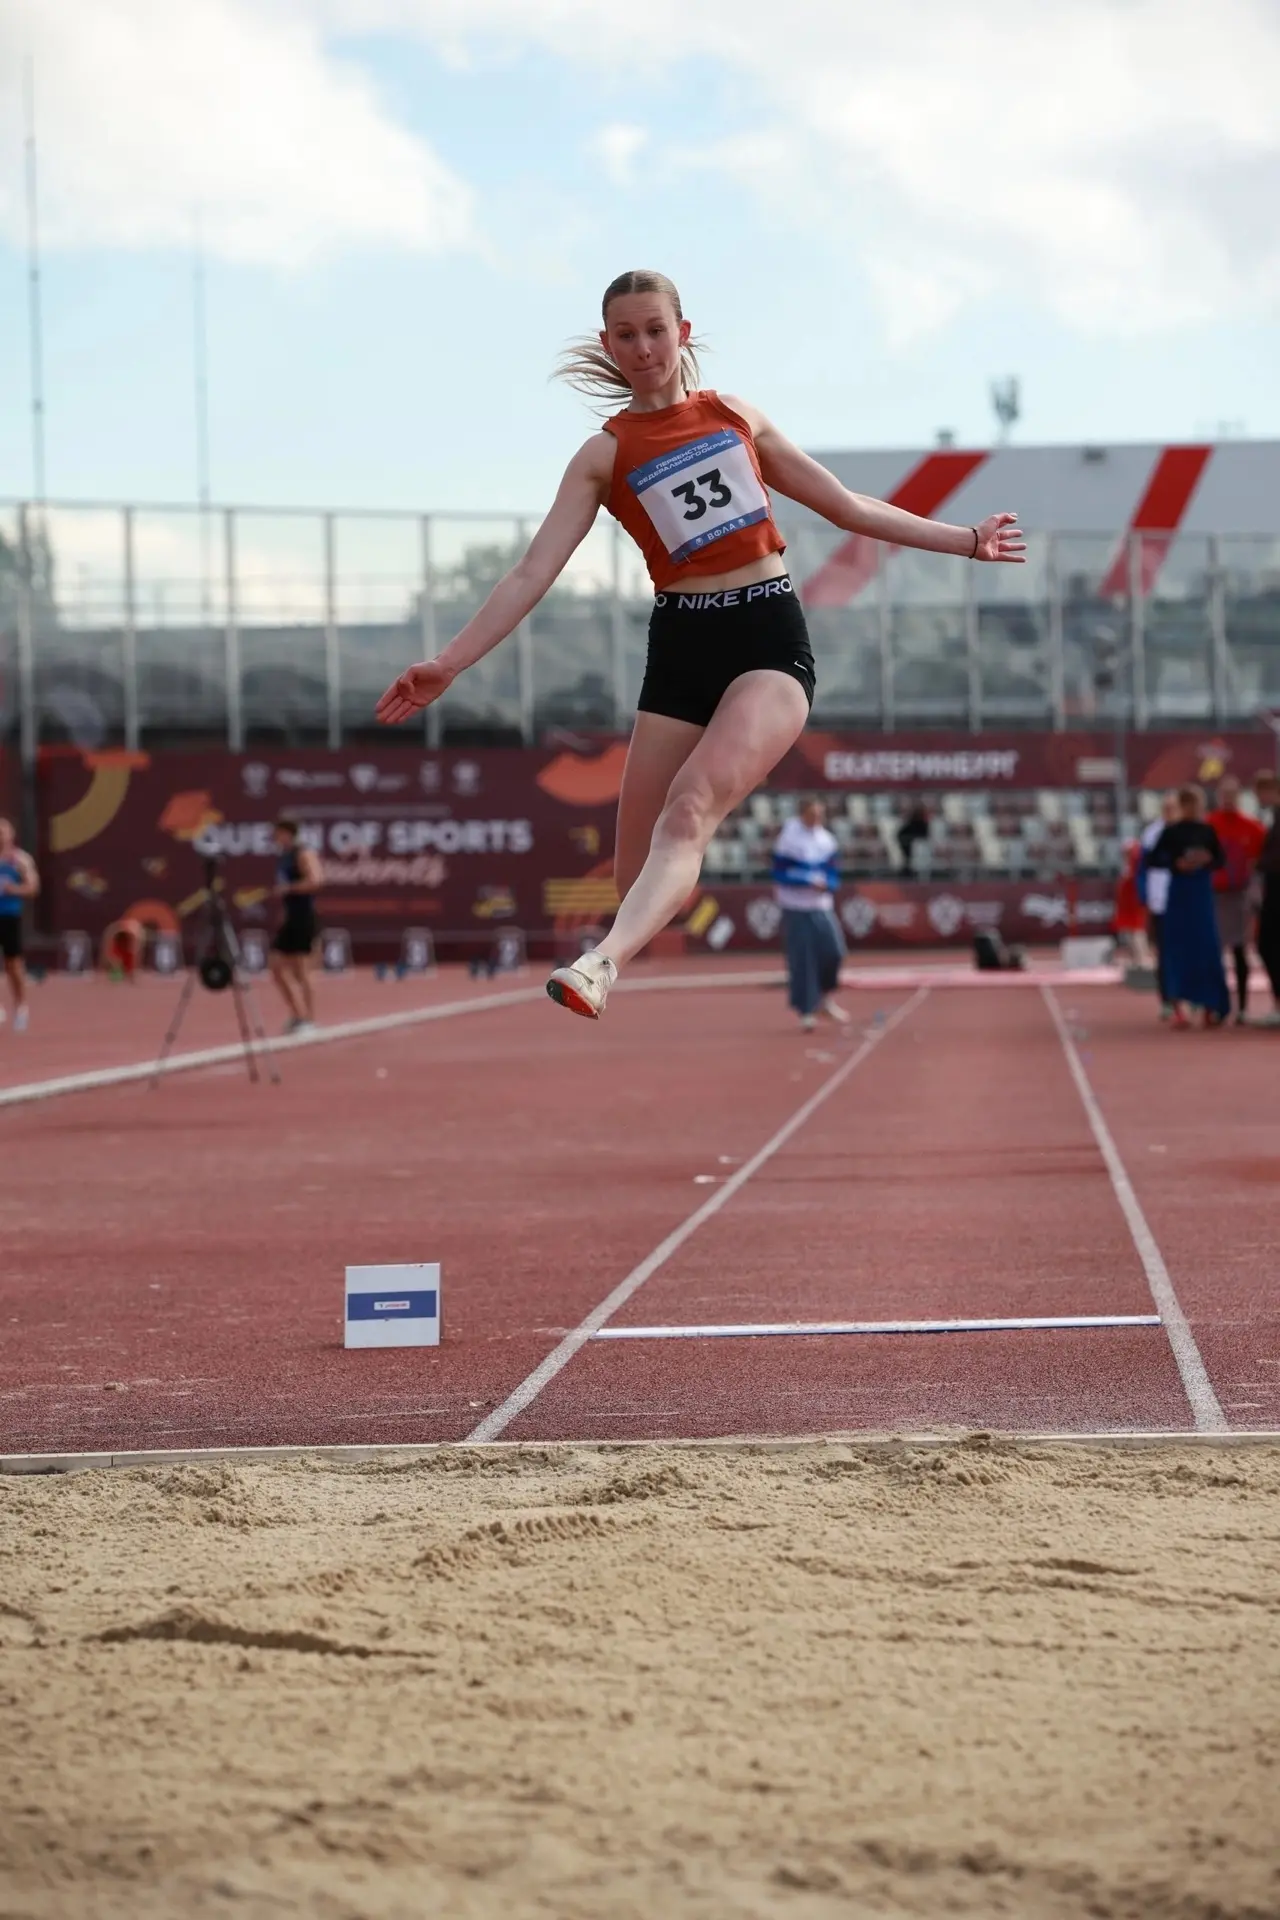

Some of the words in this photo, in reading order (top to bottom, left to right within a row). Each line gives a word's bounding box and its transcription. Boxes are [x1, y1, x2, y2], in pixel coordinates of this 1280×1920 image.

[636, 451, 702, 486] ФЕДЕРАЛЬНОГО
[702, 439, 734, 454] ОКРУГА
[655, 442, 709, 469] ПЕРВЕНСТВО
[671, 468, 732, 520] 33
[707, 523, 737, 541] ВФЛА
[678, 590, 740, 609] NIKE
[747, 578, 792, 603] PRO
[194, 822, 323, 855] QUEN
[330, 820, 382, 854] OF
[388, 819, 533, 853] SPORTS
